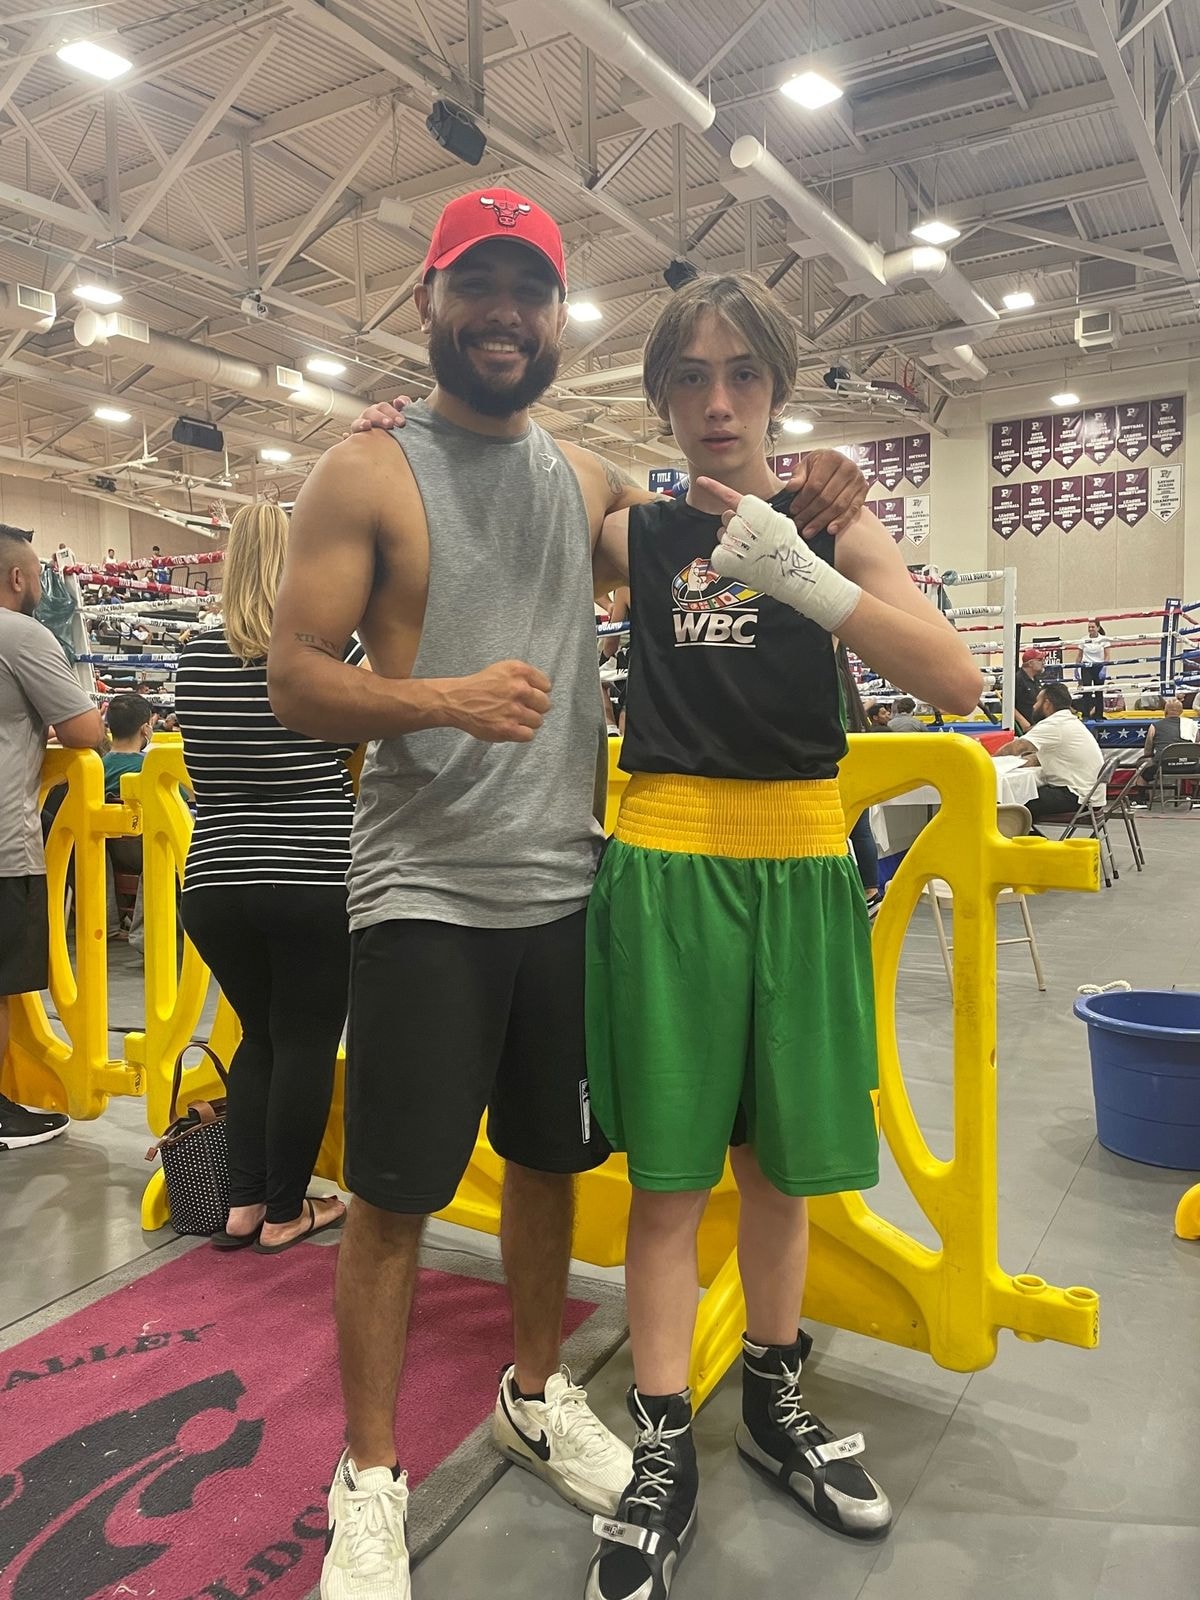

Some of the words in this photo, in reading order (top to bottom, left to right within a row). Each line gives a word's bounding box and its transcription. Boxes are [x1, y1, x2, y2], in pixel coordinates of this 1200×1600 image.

[657, 472, 671, 482] TITLE
[672, 612, 758, 644] WBC
[4, 1323, 215, 1391] ALLEY
